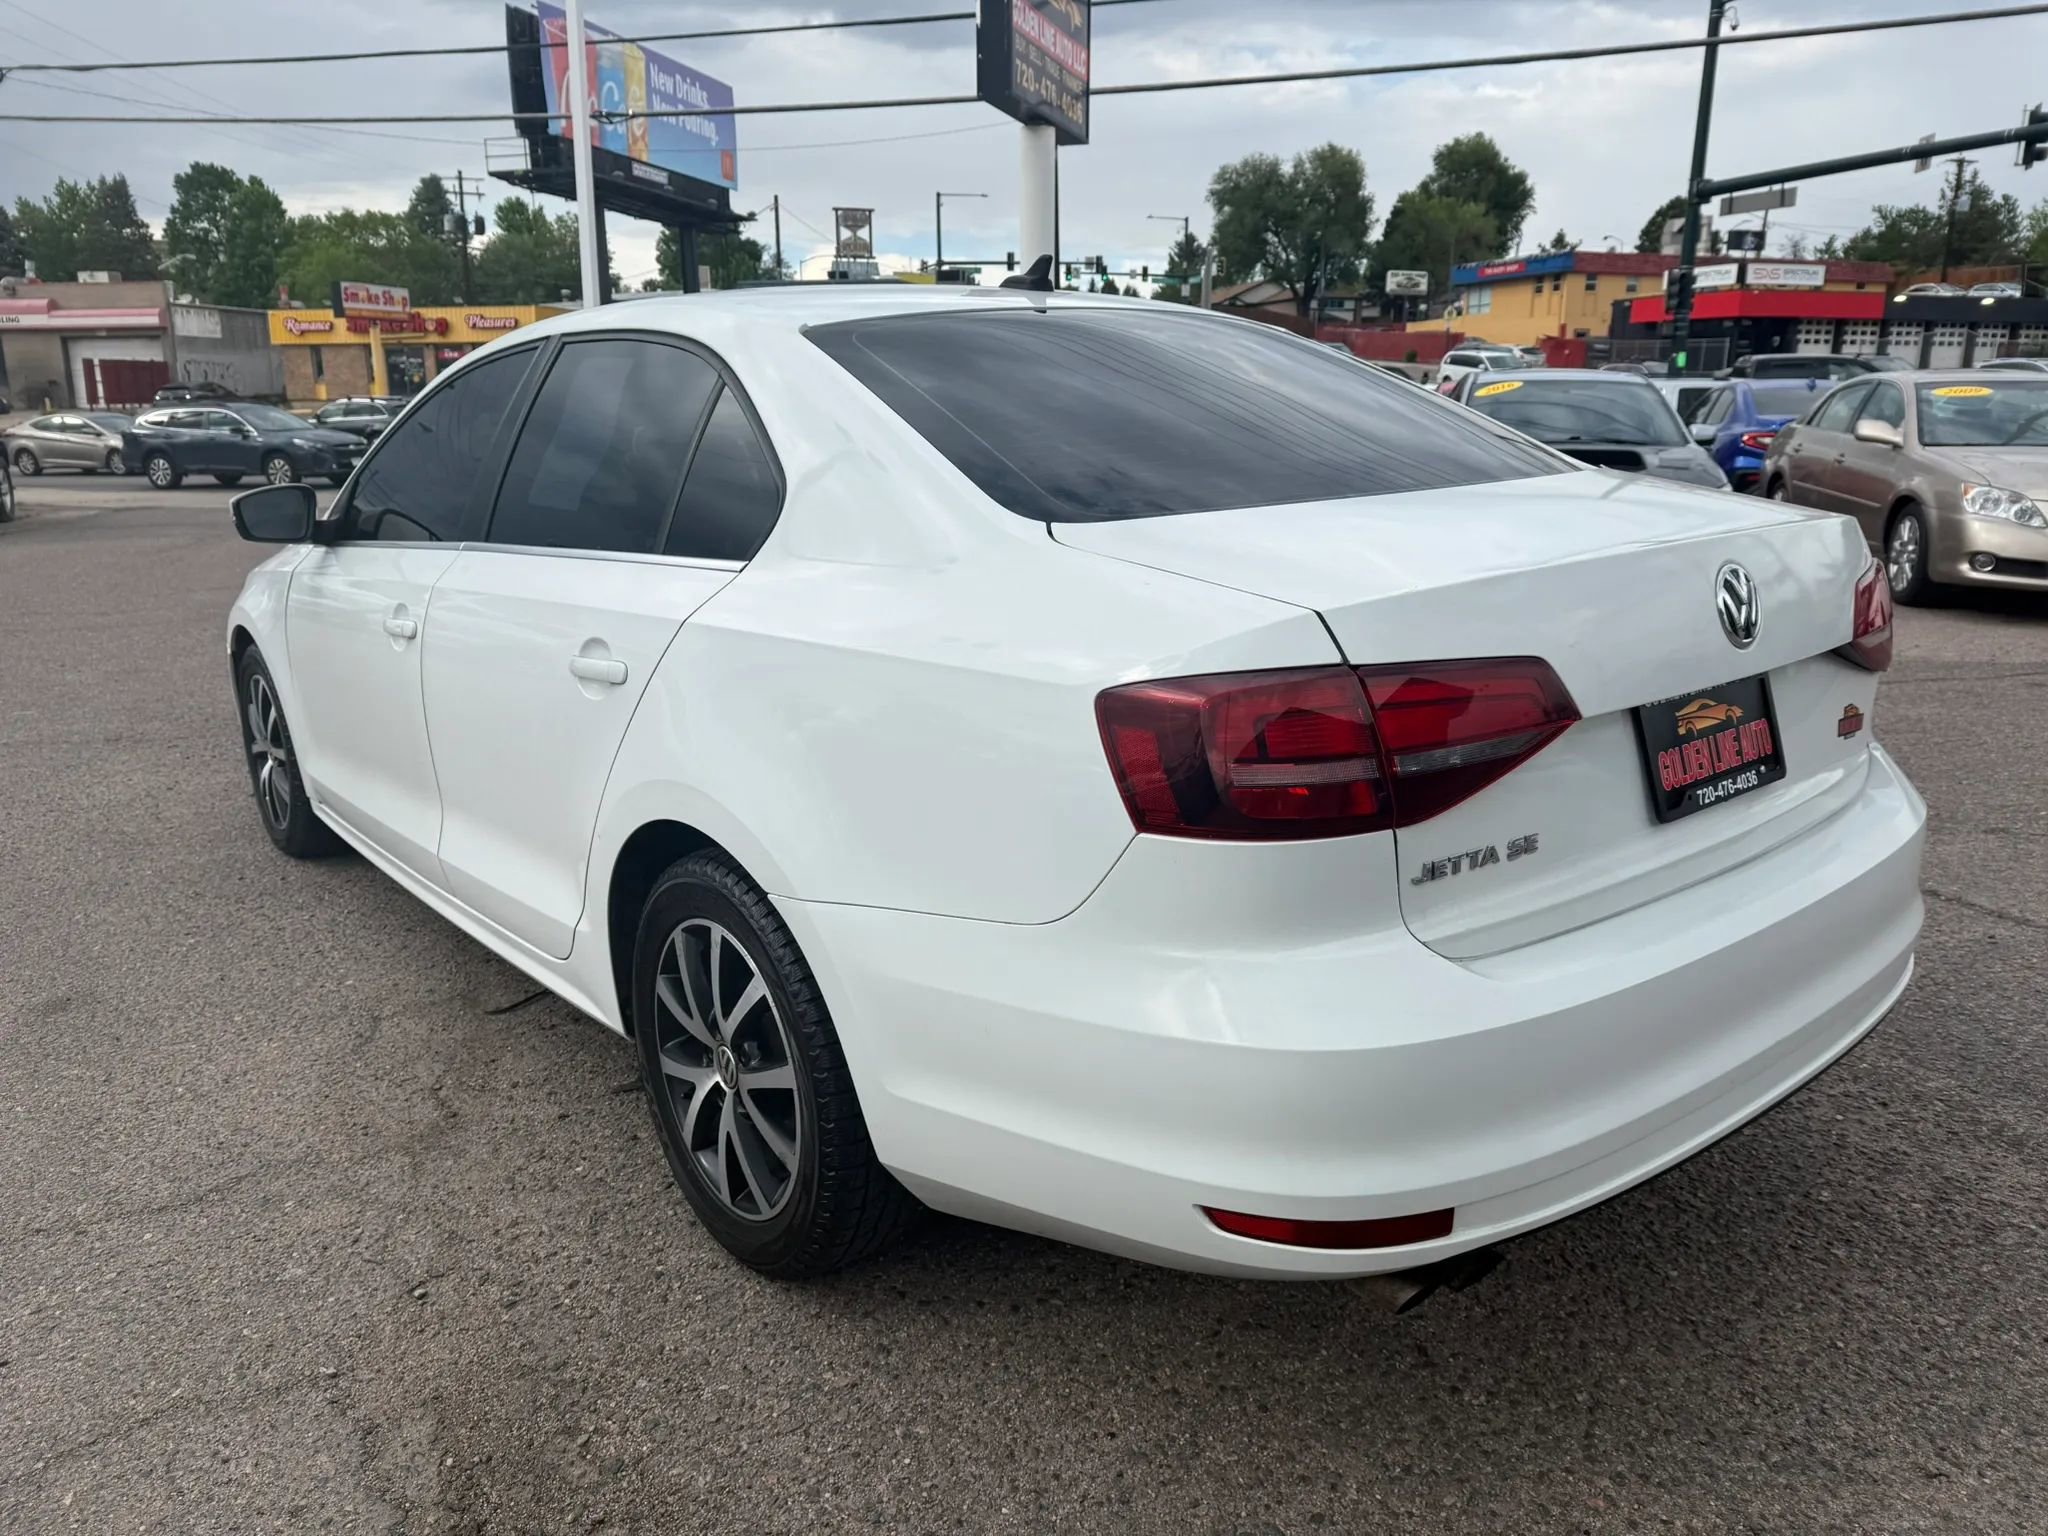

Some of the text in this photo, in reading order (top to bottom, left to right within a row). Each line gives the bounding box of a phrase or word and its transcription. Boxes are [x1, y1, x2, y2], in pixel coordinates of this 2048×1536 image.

[1040, 16, 1055, 53] LINE
[1055, 30, 1073, 65] AUTO
[1073, 43, 1087, 75] LLC
[649, 62, 675, 95] New
[652, 94, 677, 126] Now
[343, 286, 409, 313] Smoke Shop
[283, 316, 333, 336] Romance
[464, 313, 518, 329] Pleasures
[1658, 718, 1773, 792] GOLDEN LINE AUTO
[1696, 769, 1759, 806] 720-476-4036
[1411, 832, 1540, 886] JETTA SE
